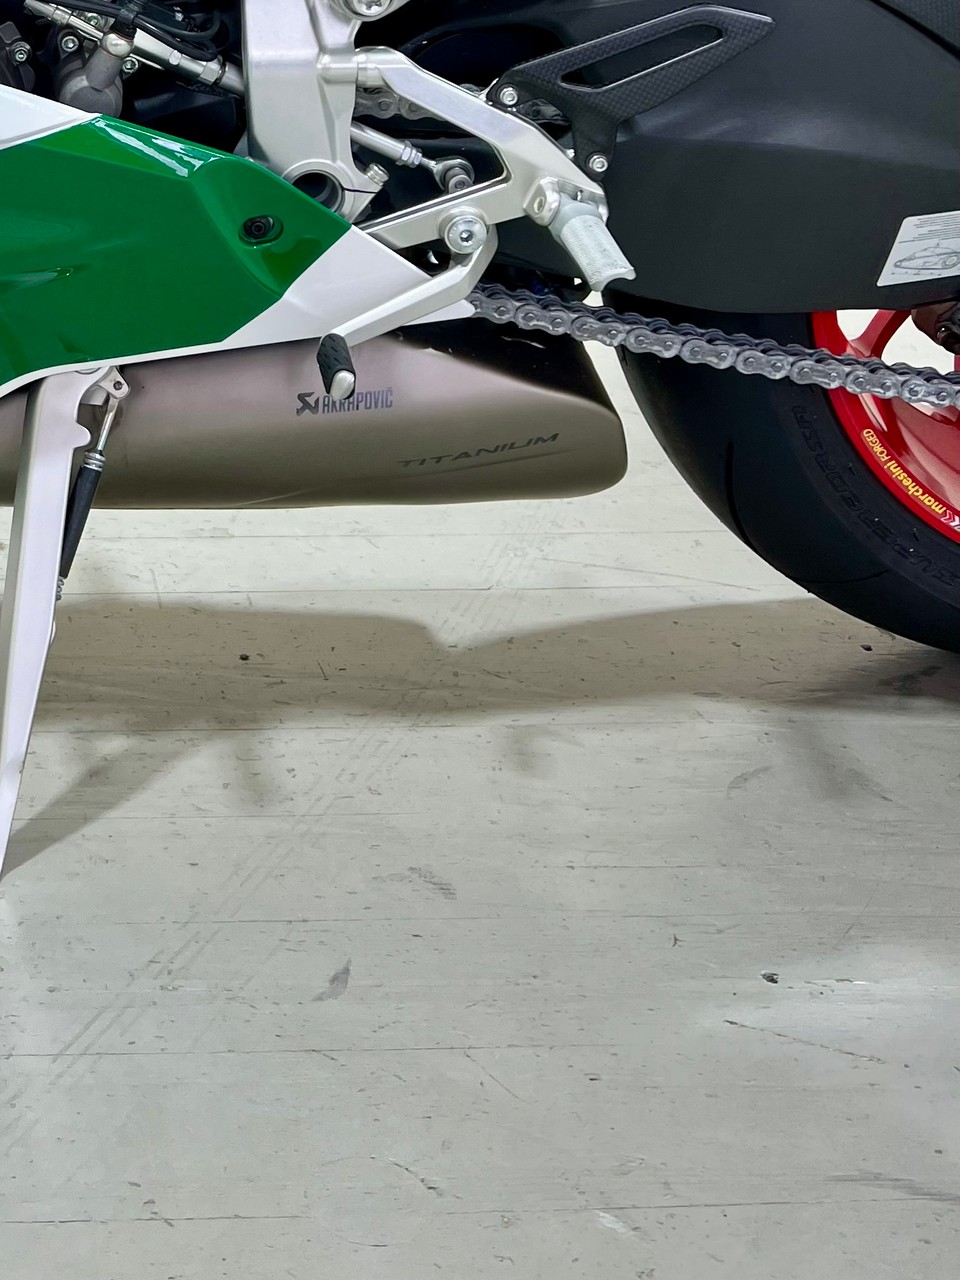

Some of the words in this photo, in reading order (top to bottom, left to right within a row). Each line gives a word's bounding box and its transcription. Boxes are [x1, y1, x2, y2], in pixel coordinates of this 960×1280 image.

[397, 432, 561, 468] TITANIUM
[862, 428, 892, 462] FORGED
[883, 460, 947, 514] marchesini
